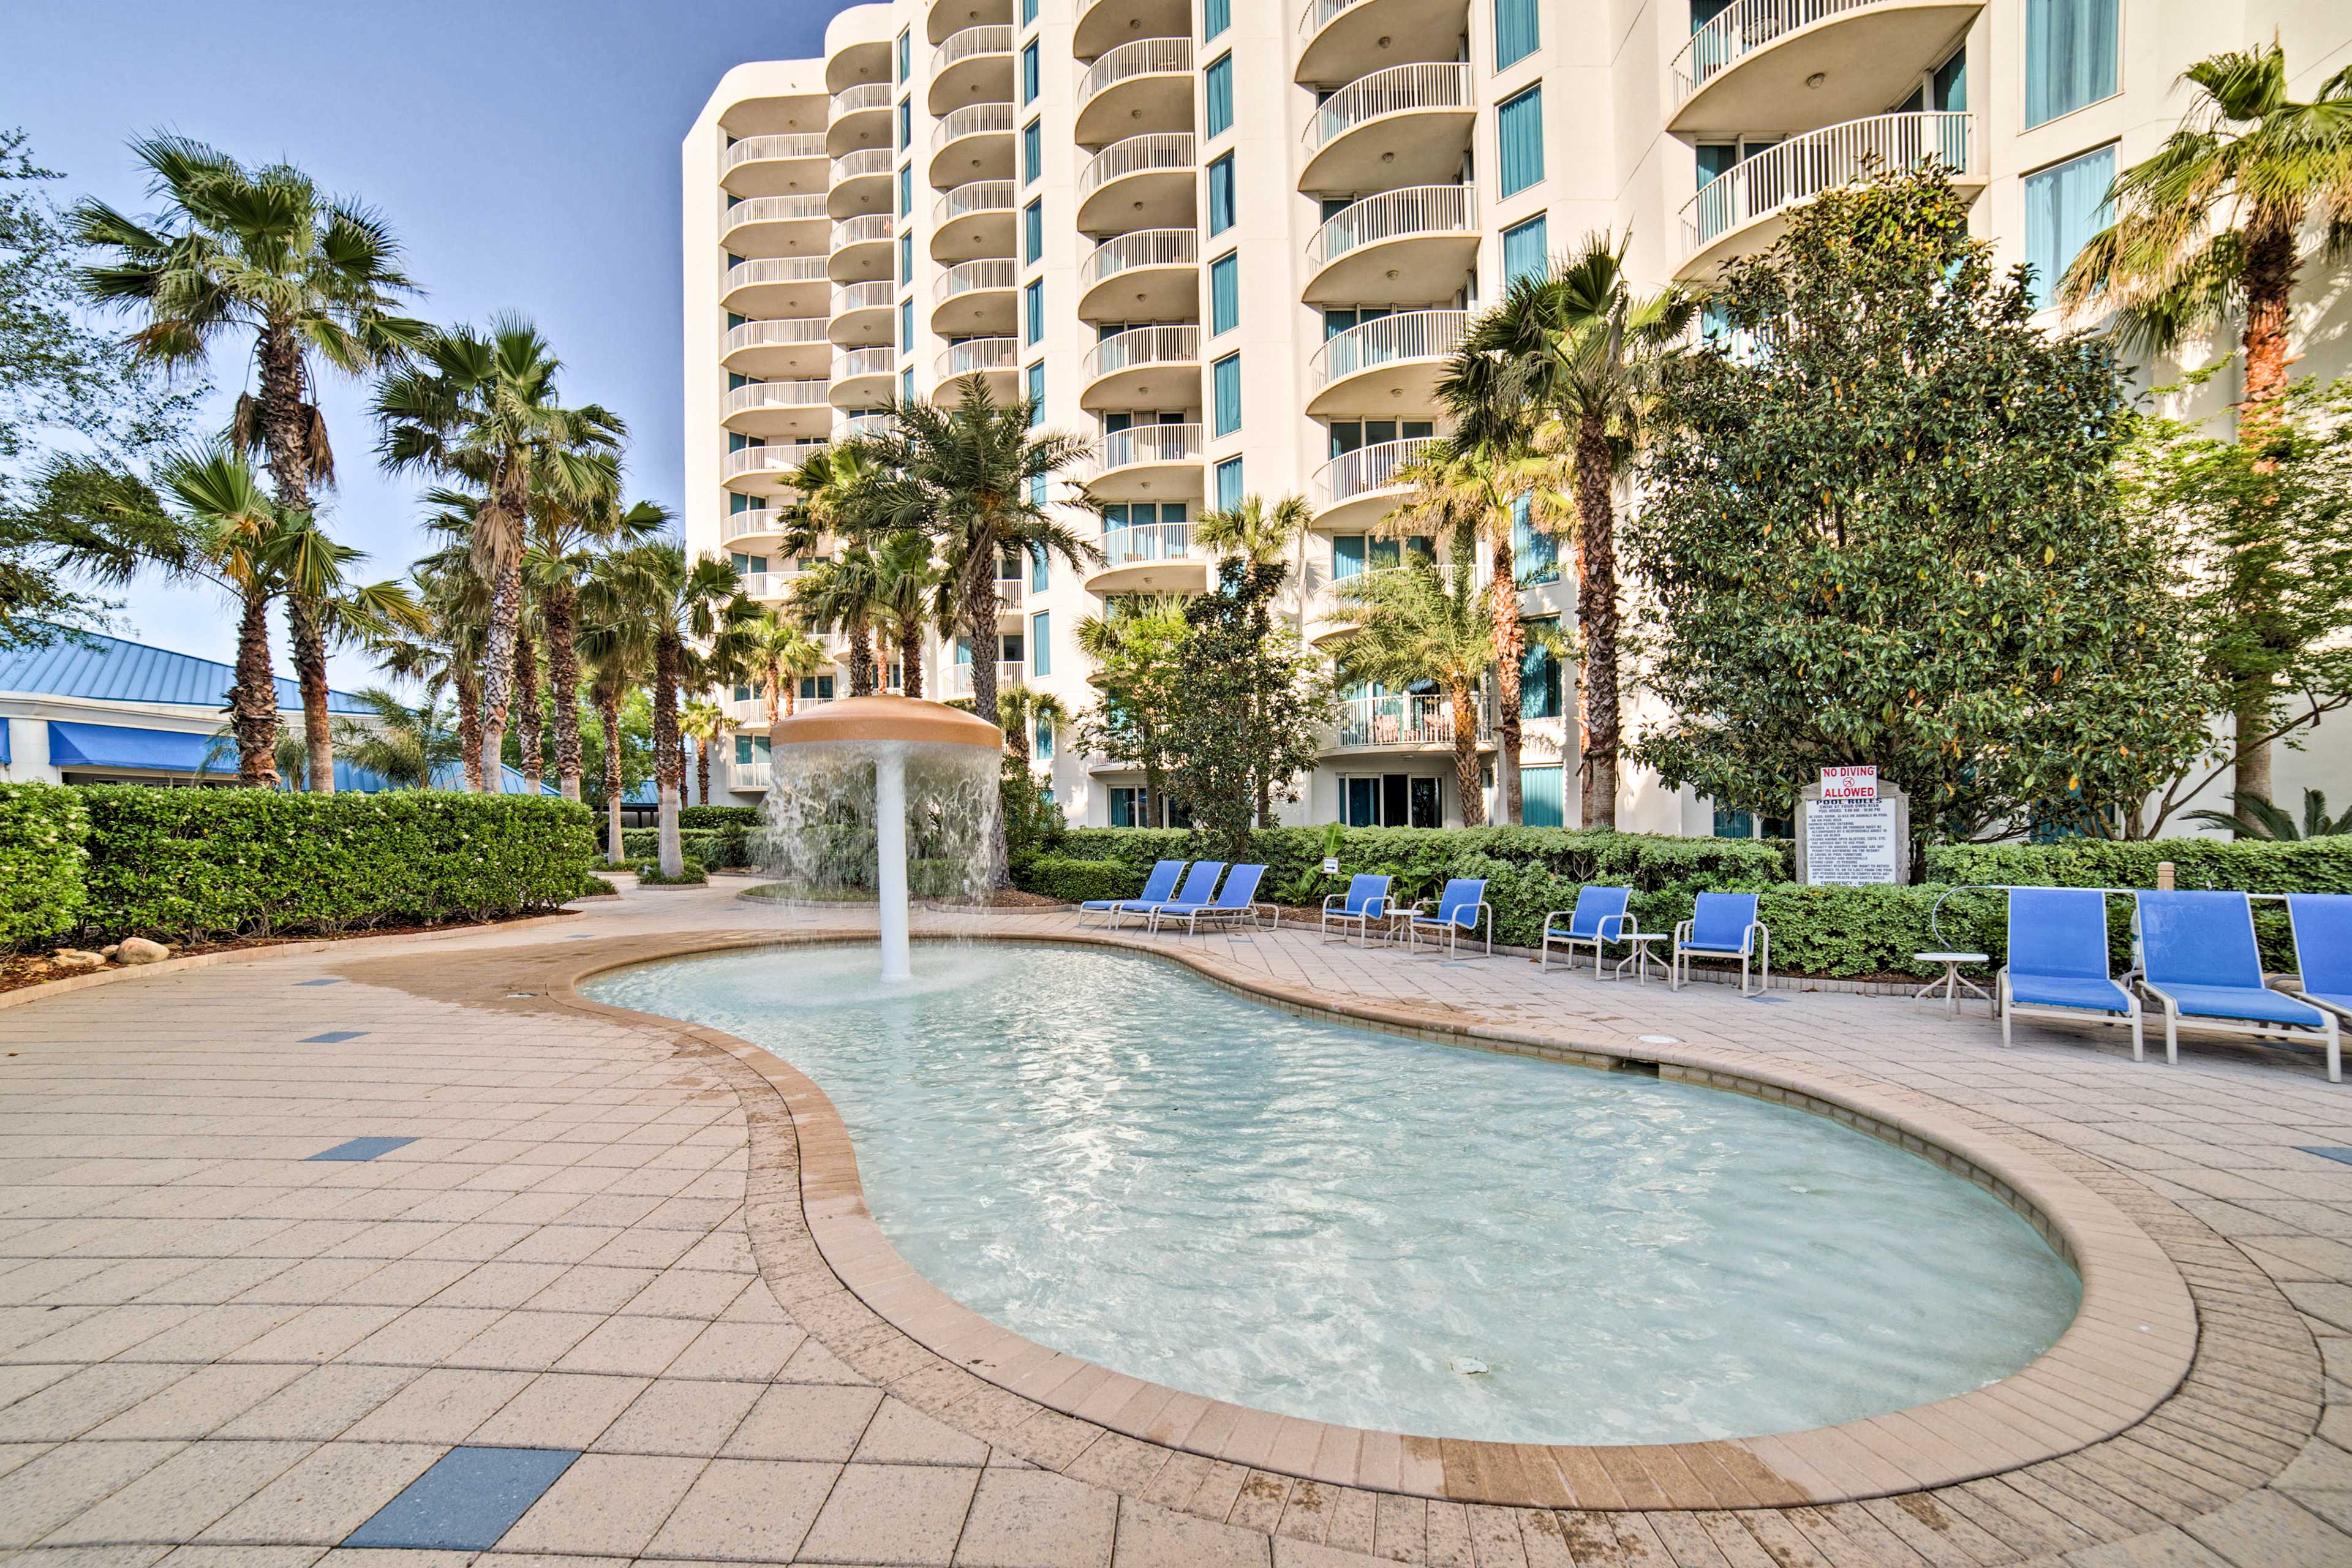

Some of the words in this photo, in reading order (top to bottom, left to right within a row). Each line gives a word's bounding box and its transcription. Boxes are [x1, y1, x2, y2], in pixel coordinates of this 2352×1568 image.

[1823, 768, 1837, 777] NO
[1841, 767, 1874, 776] DIVING
[1825, 787, 1874, 797] ALLOWED
